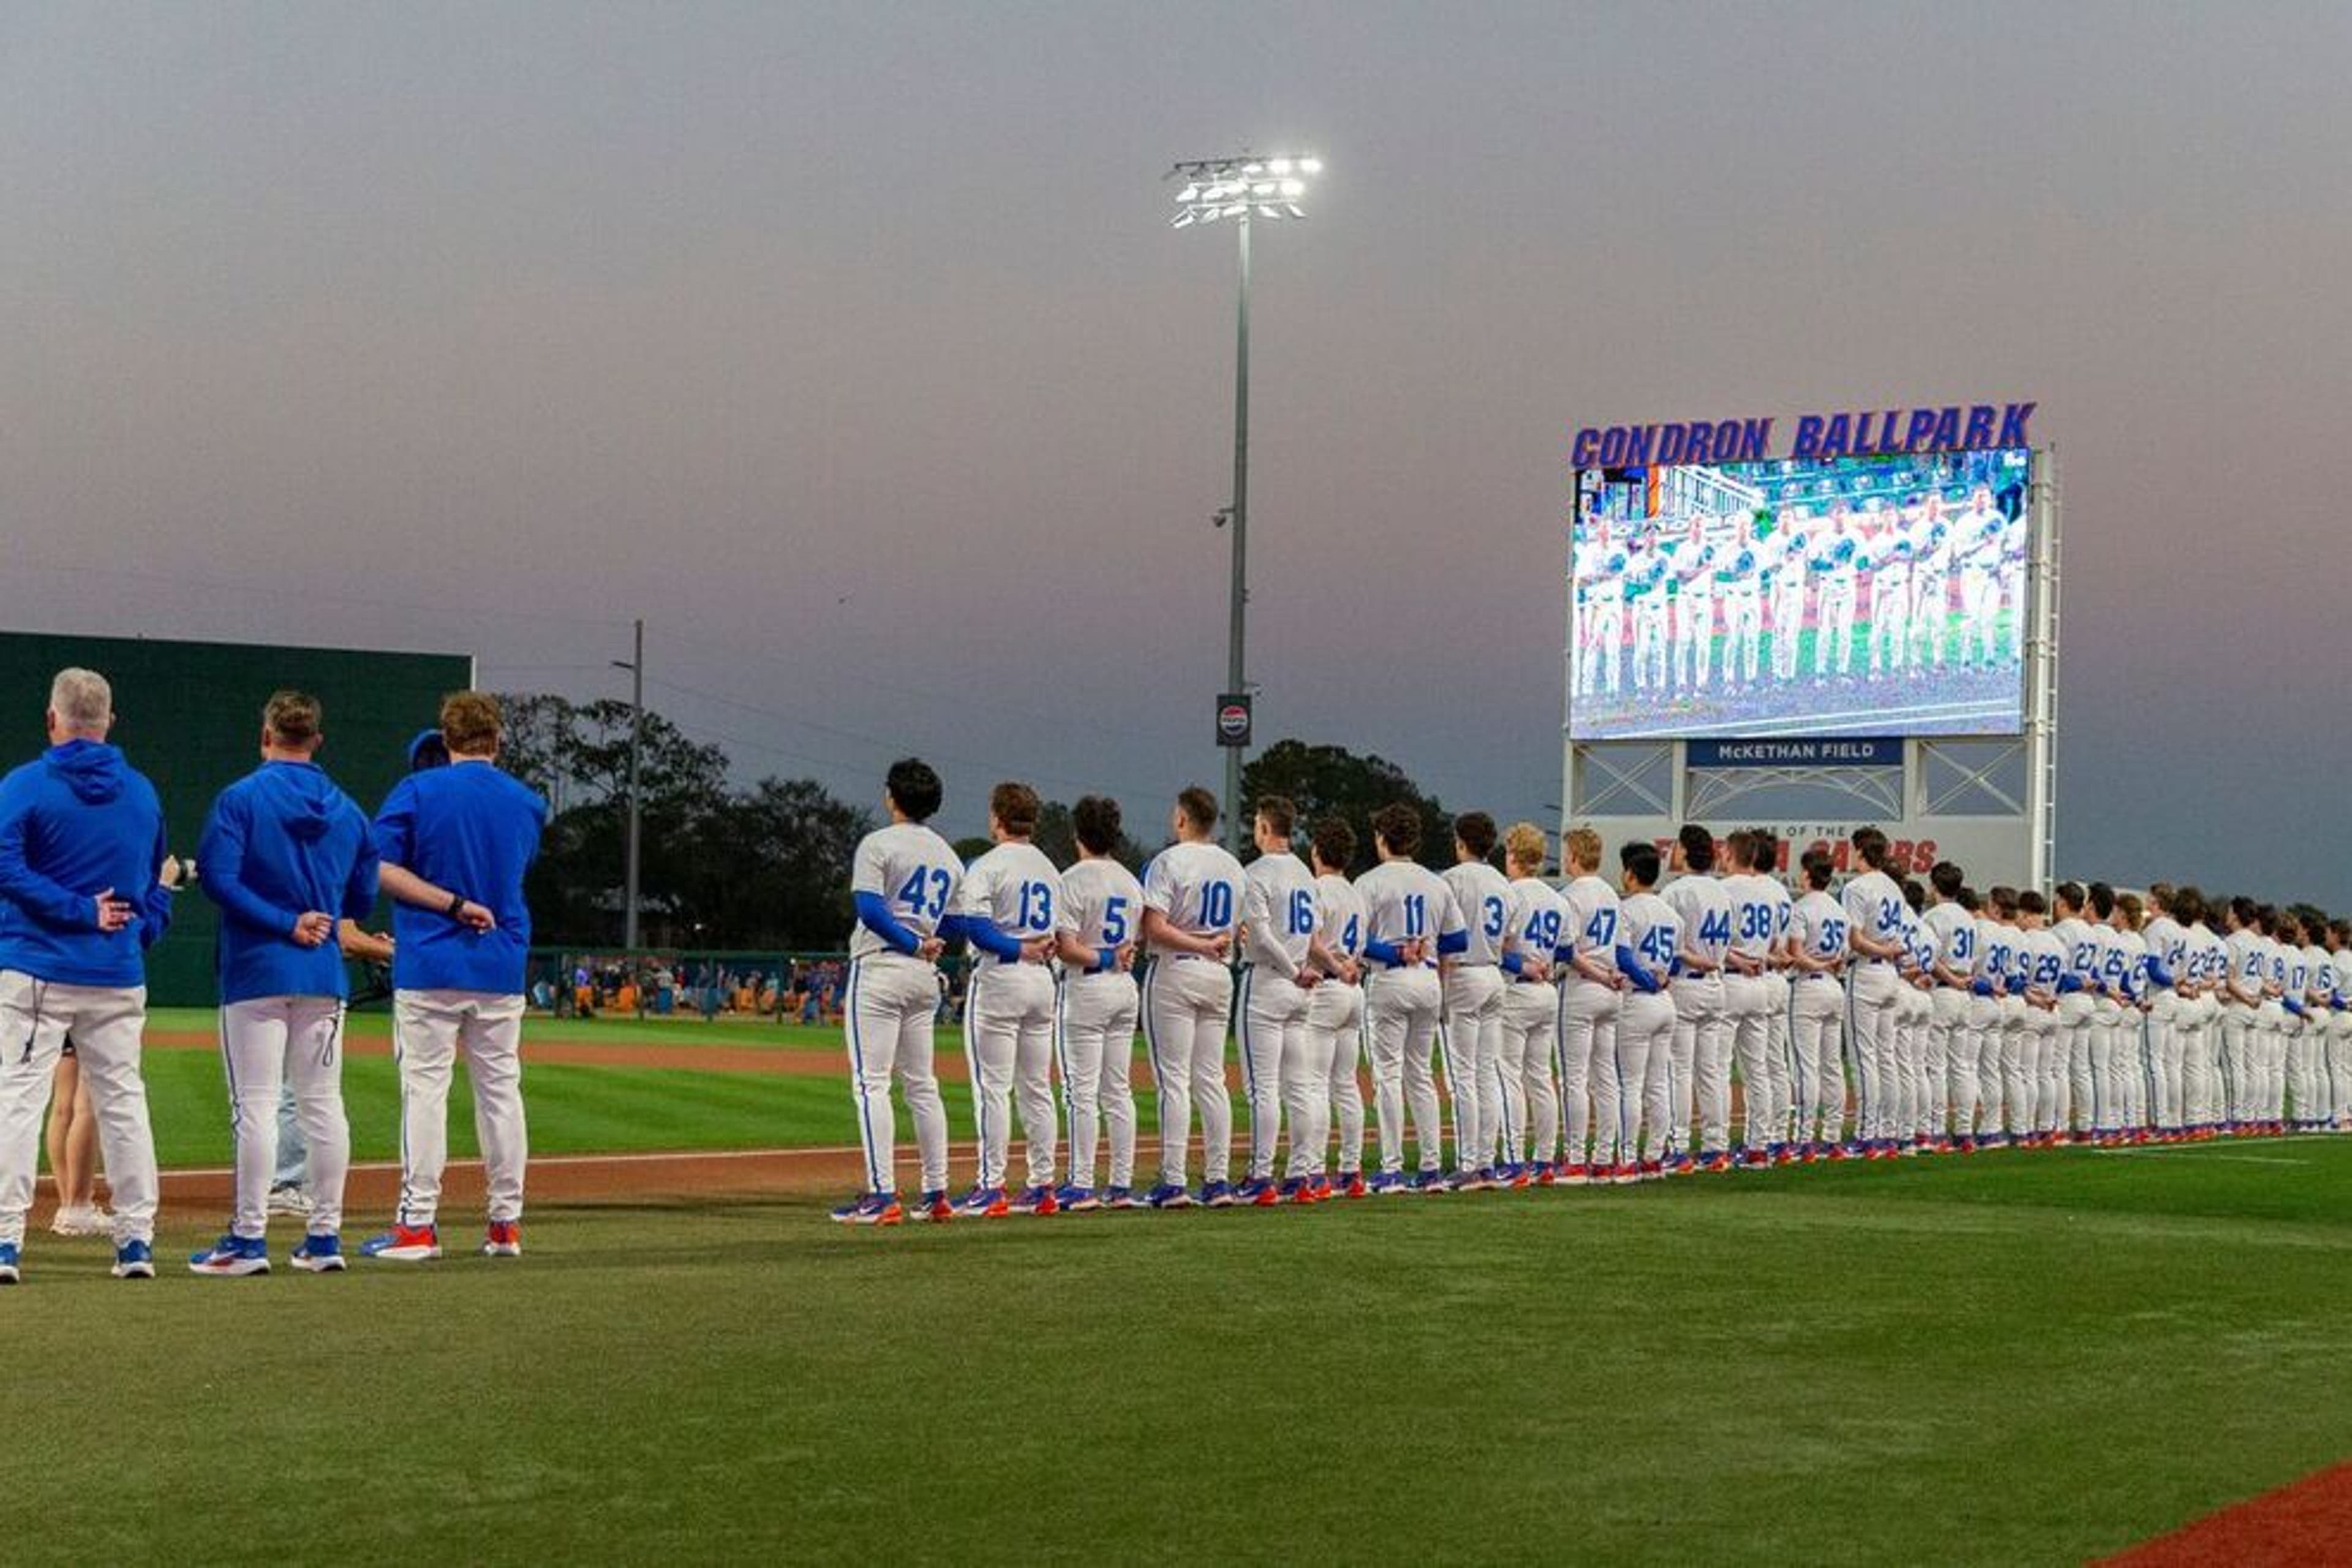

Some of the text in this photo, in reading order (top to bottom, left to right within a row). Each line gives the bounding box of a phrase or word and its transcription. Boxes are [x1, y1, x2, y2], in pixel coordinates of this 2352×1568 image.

[1571, 401, 2037, 468] CONDRON BALLPARK
[1719, 742, 1873, 760] McKETHAN FIELD
[1815, 826, 1845, 837] THE
[898, 864, 952, 919] 43
[1017, 880, 1052, 930] 13
[1199, 880, 1232, 927] 10
[1101, 897, 1127, 944] 5
[1289, 890, 1313, 935] 16
[1404, 894, 1424, 937] 11
[1483, 895, 1504, 937] 3
[1524, 910, 1562, 949] 49
[1586, 908, 1617, 946] 47
[1699, 910, 1731, 946] 44
[1740, 902, 1772, 939] 38
[1877, 897, 1902, 932] 34
[1342, 914, 1358, 955] 4
[1639, 925, 1675, 963] 45
[1953, 928, 1975, 959] 31
